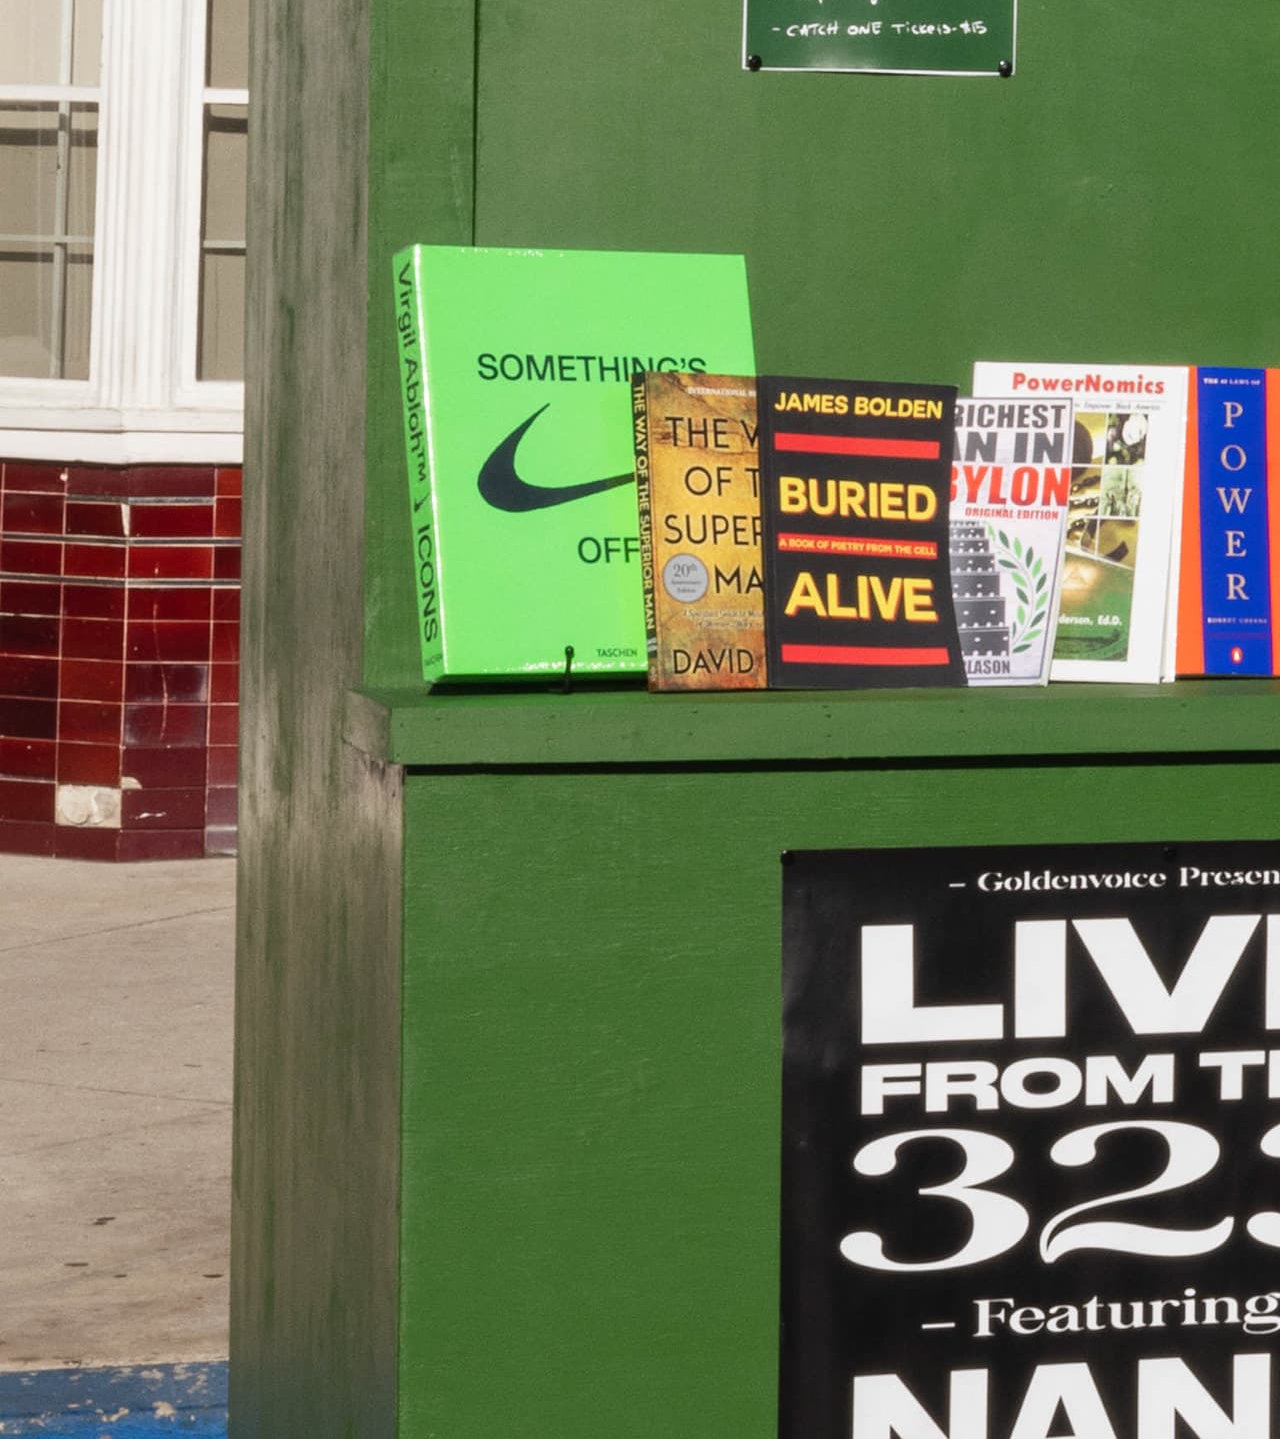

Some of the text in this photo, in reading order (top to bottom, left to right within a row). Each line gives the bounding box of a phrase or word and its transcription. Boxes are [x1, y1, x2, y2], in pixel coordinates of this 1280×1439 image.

[786, 21, 838, 37] CATCH
[847, 21, 883, 35] ONE
[1012, 371, 1165, 395] PowerNomics
[633, 383, 646, 413] THE
[774, 392, 943, 419] JAMES BOLDEN
[634, 416, 648, 452] WAY
[665, 416, 730, 448] THE
[397, 262, 417, 348] Virgil
[418, 523, 438, 643] ICONS
[1013, 431, 1065, 463] IN
[636, 455, 649, 481] OF
[684, 466, 733, 496] OF
[638, 484, 650, 512] THE
[779, 476, 938, 522] BURIED
[1215, 401, 1253, 601] POWER
[965, 508, 1060, 521] ORIGINAL EDITION
[577, 537, 640, 564] OFF
[639, 513, 654, 591] SUPERIOR
[778, 538, 937, 555] A BOOK OF POETRY FROM THE CELL
[645, 593, 656, 629] MAN
[784, 572, 939, 622] ALIVE
[1097, 614, 1122, 625] Ed.D.
[597, 648, 637, 658] TASCHEN
[673, 649, 754, 674] DAVID
[964, 658, 1011, 674] LASON
[977, 870, 1167, 892] Goldenvoice
[861, 1053, 1175, 1116] FROM
